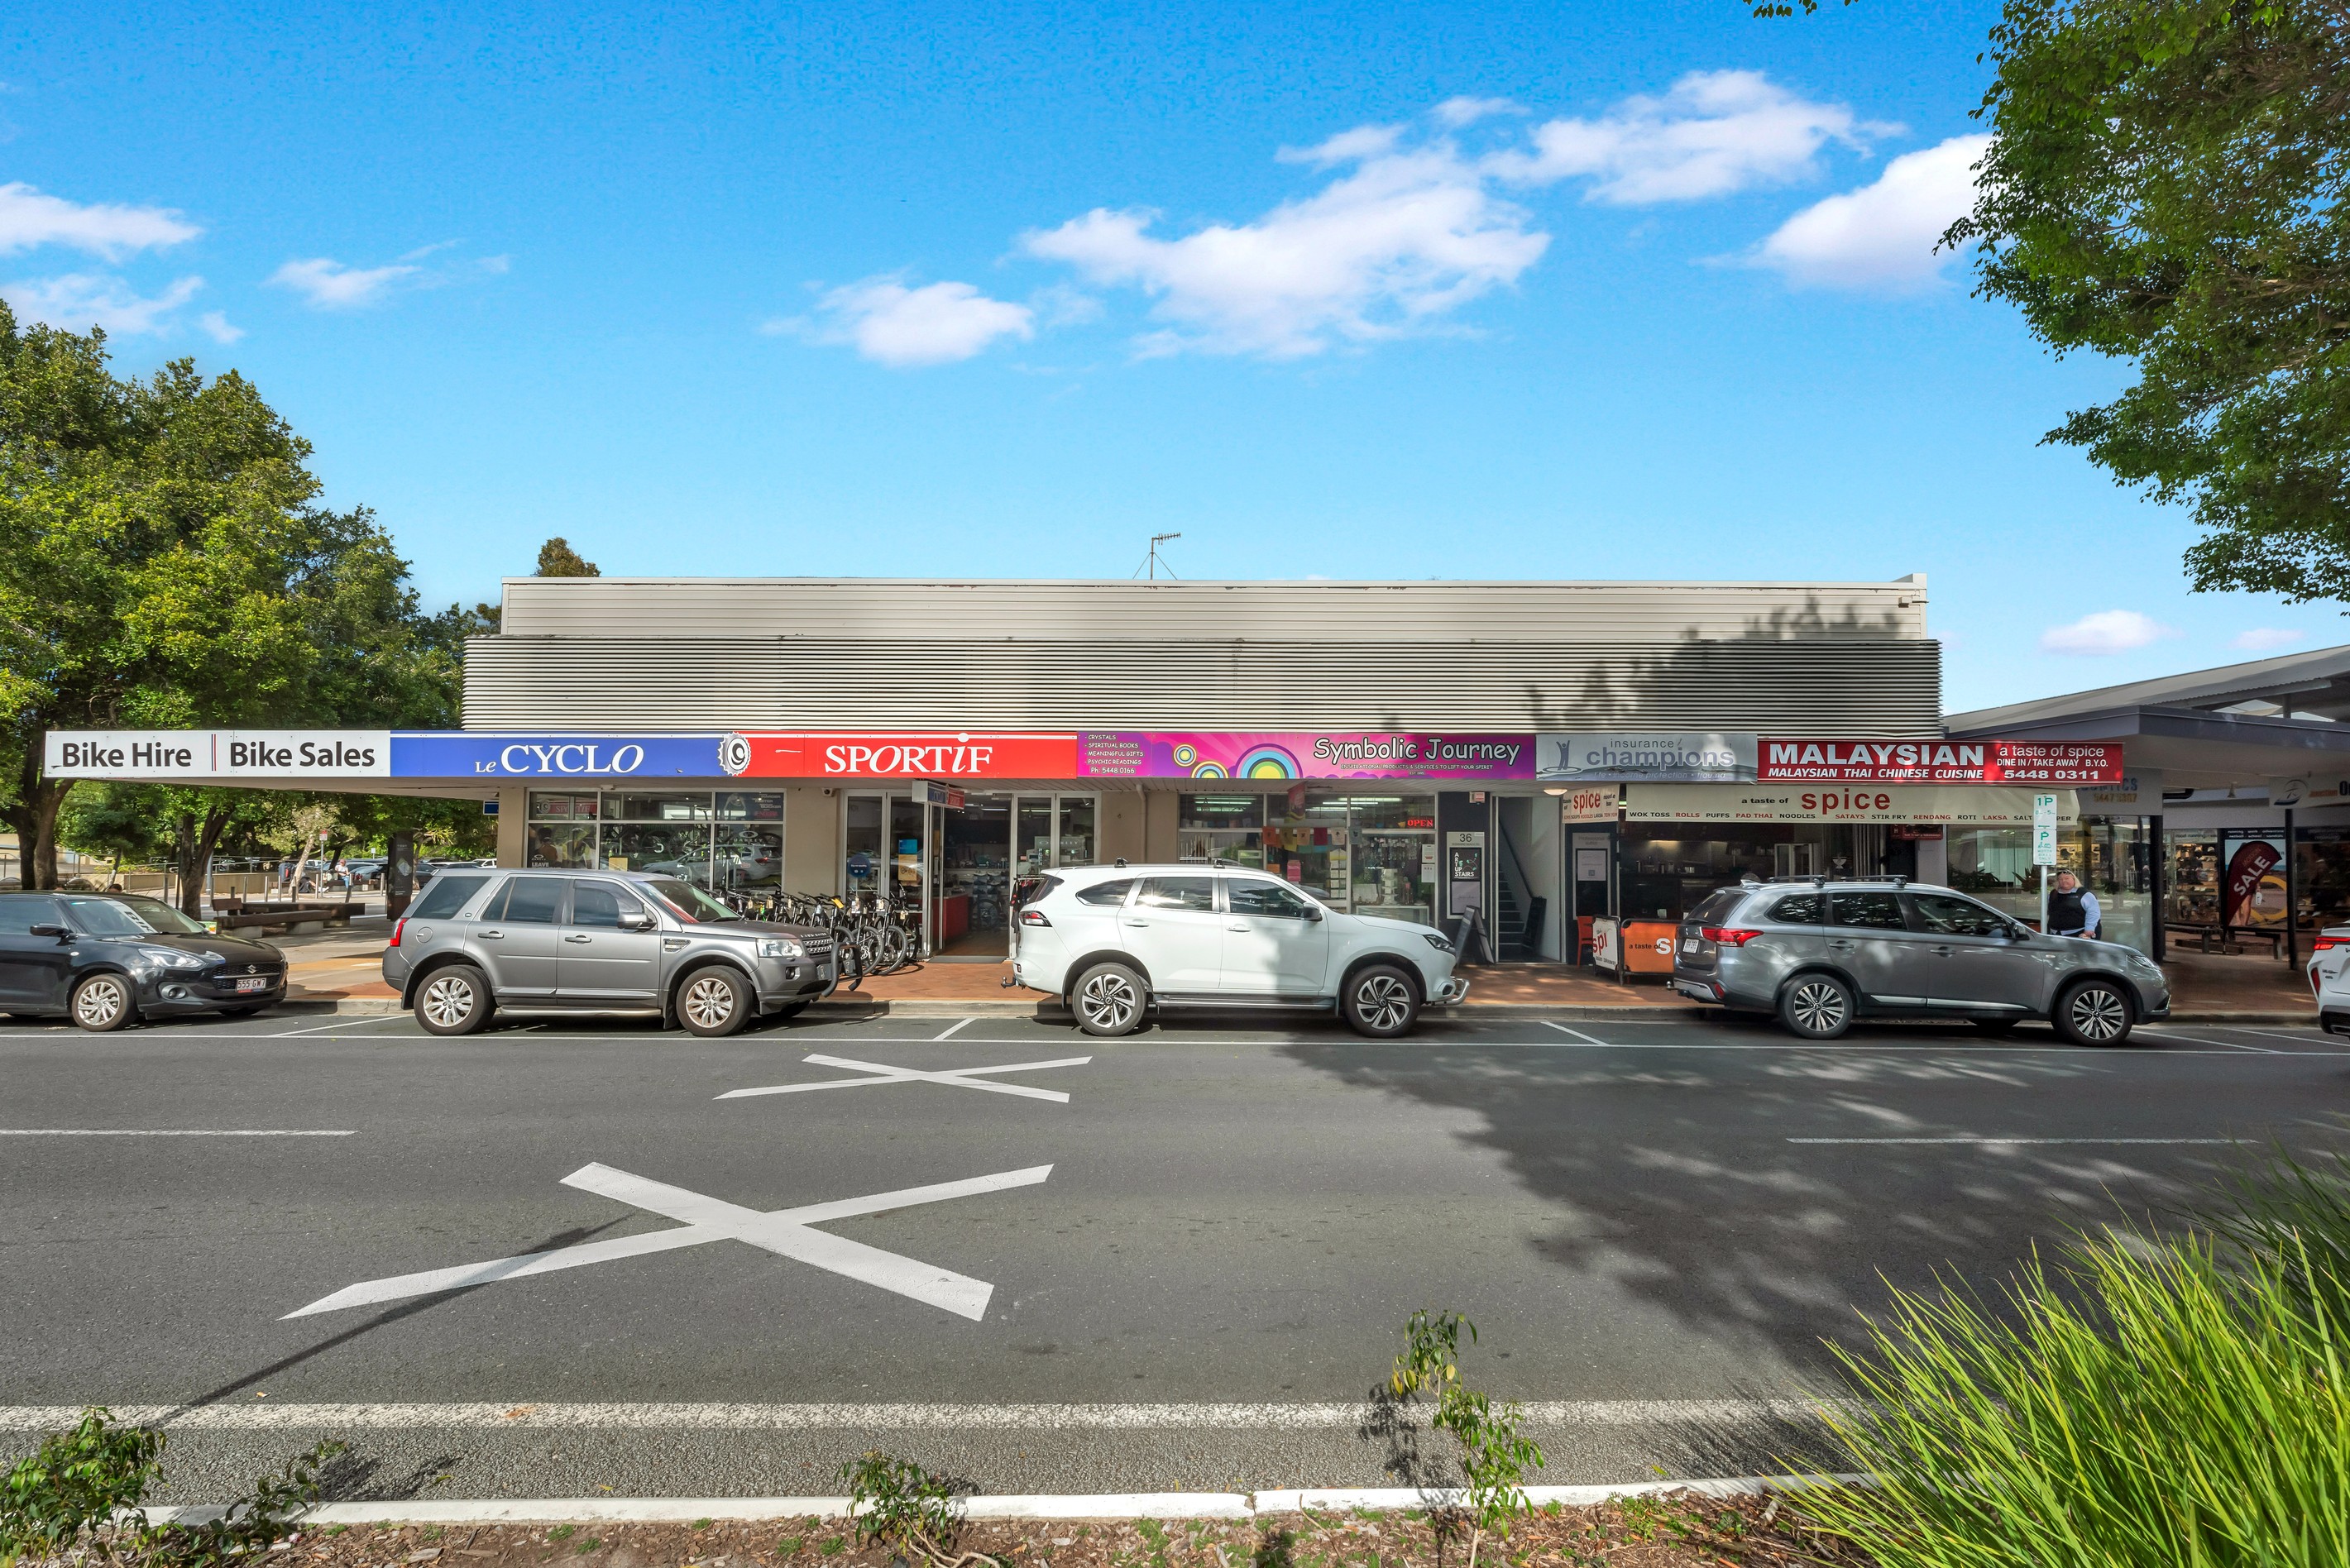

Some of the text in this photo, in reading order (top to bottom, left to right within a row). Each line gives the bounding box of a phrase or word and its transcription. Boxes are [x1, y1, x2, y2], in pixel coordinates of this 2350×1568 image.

[63, 742, 192, 767] Bike Hire
[230, 741, 376, 767] Bike Sales
[1314, 736, 1521, 766] Symbolic Journey
[1611, 739, 1675, 748] insurance
[1768, 743, 1984, 766] MALAYSIAN
[1999, 745, 2104, 759] a taste of spice
[475, 744, 644, 773] Le CYCLO
[1587, 747, 1735, 771] champions
[2085, 759, 2108, 767] B.Y.O.
[1768, 768, 1984, 779] MALAYSIAN THAI CHINESE CUISINE
[2003, 770, 2099, 779] 5448 0311
[1573, 789, 1601, 814] spice
[1801, 787, 1891, 815] spice
[1459, 833, 1472, 843] 36
[2041, 832, 2049, 840] P
[2233, 855, 2271, 896] SALE
